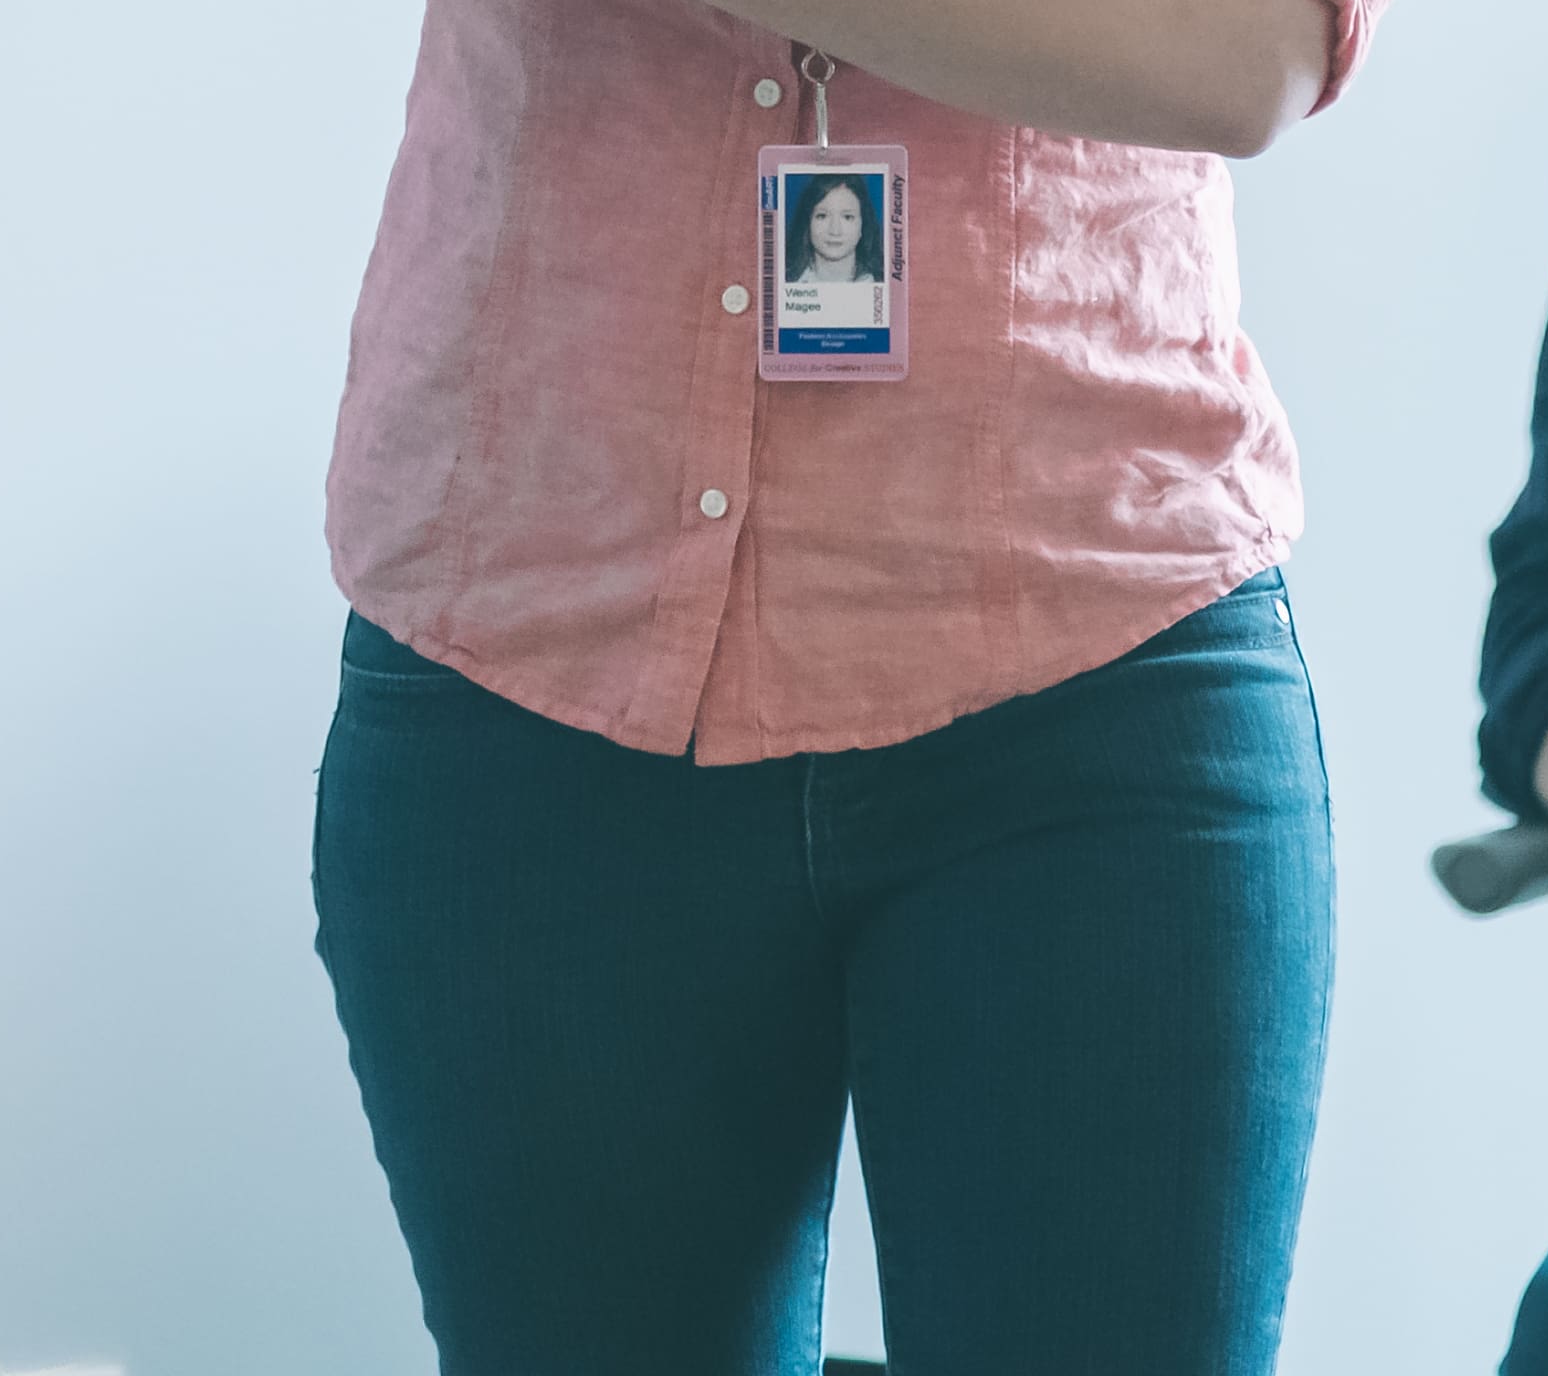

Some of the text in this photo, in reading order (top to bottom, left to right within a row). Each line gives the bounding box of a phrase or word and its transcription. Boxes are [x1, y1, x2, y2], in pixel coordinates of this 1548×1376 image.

[890, 174, 906, 282] Adjunct Faculty
[785, 288, 818, 299] Wendi
[785, 302, 821, 314] Magee
